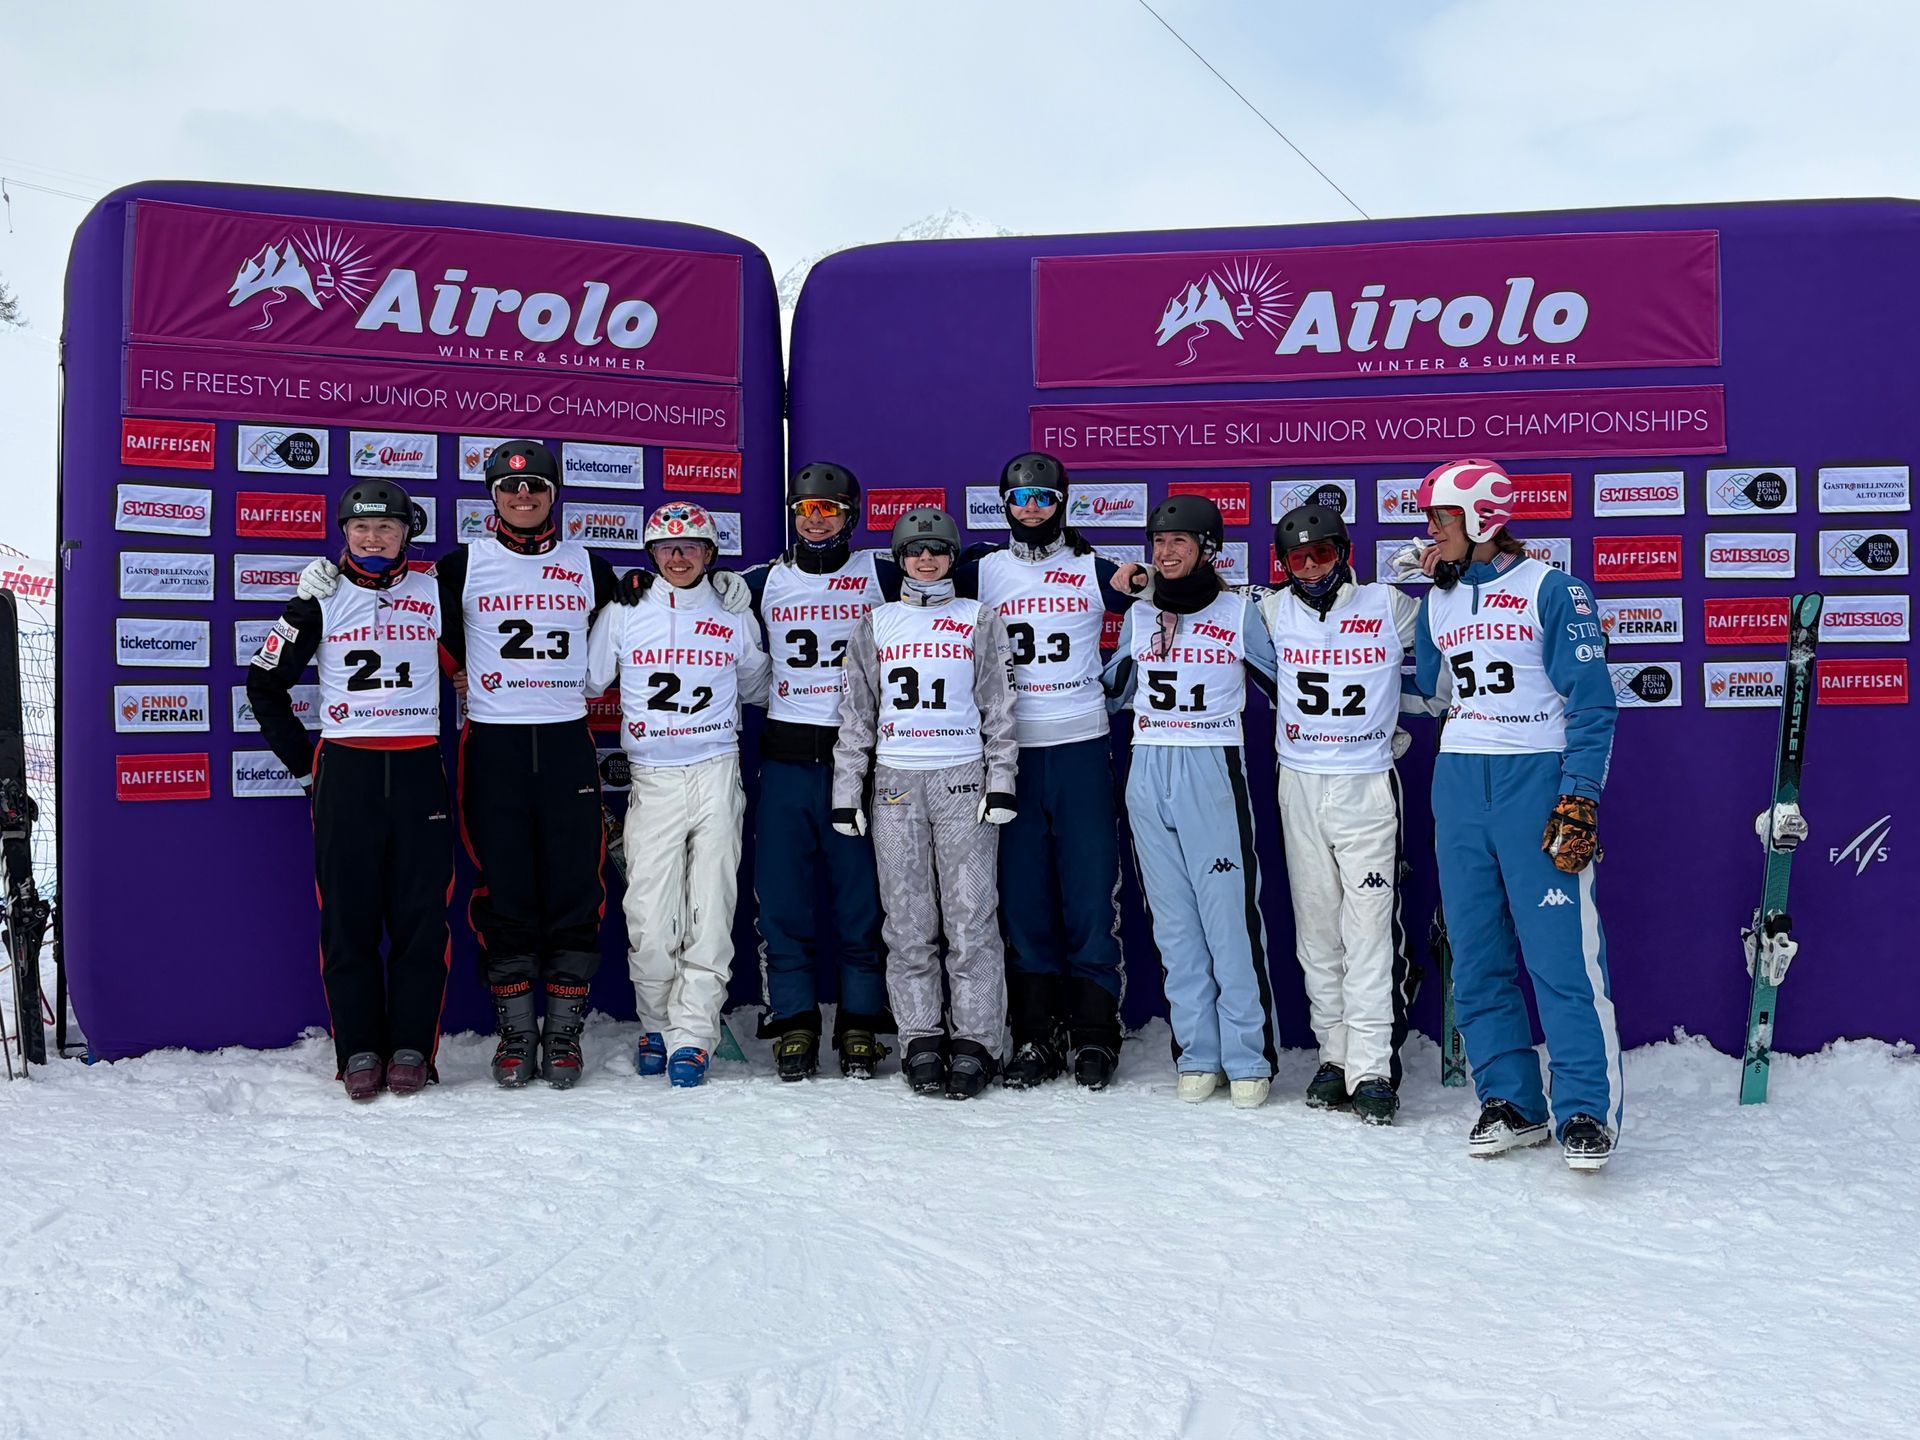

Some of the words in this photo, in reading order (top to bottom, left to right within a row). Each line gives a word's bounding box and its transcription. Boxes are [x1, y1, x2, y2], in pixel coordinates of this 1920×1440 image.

[355, 268, 658, 349] Airolo
[1275, 277, 1589, 355] Airolo
[438, 346, 524, 362] WINTER
[537, 352, 547, 363] &
[559, 353, 646, 370] SUMMER
[1357, 358, 1445, 373] WINTER
[1458, 356, 1469, 368] &
[1483, 353, 1577, 367] SUMMER
[141, 369, 174, 390] FIS
[183, 371, 311, 399] FREESTYLE
[319, 381, 352, 402] SKI
[361, 384, 448, 409] JUNIOR
[455, 390, 541, 412] WORLD
[548, 395, 726, 428] CHAMPIONSHIPS
[1045, 427, 1077, 448] FIS
[1085, 424, 1217, 447] FREESTYLE
[1225, 422, 1260, 444] SKI
[1269, 419, 1366, 443] JUNIOR
[1375, 416, 1475, 440] WORLD
[1485, 409, 1708, 437] CHAMPIONSHIPS
[126, 434, 210, 453] RAIFFEISEN
[289, 447, 313, 456] ZONA
[379, 446, 424, 465] Quinto
[566, 459, 633, 475] ticketcorner
[667, 463, 737, 479] RAIFFEISEN
[1600, 486, 1678, 502] SWISSLOS
[1756, 487, 1780, 496] ZONA
[1876, 491, 1905, 499] TICINO
[123, 500, 205, 520] SWISSLOS
[1092, 497, 1134, 515] Quinto
[240, 507, 322, 523] RAIFFEISEN
[585, 514, 626, 526] ENNIO
[584, 526, 638, 540] FERRARI
[1598, 550, 1677, 566] RAIFFEISEN
[1710, 548, 1790, 564] SWISSLOS
[1868, 548, 1892, 557] ZONA
[159, 577, 181, 585] ALTO
[182, 577, 209, 586] TICINO
[1570, 587, 1585, 596] US
[478, 594, 587, 612] RAIFFEISEN
[772, 604, 872, 622] RAIFFEISEN
[1618, 608, 1662, 620] ENNIO
[1708, 614, 1788, 628] RAIFFEISEN
[1823, 611, 1903, 627] SWISSLOS
[1618, 620, 1677, 633] FERRARI
[120, 635, 197, 651] ticketcorner
[498, 619, 570, 660] 2.3
[1006, 622, 1070, 665] 3.3
[1438, 623, 1534, 652] RAIFFEISEN
[785, 628, 848, 668] 3.2
[632, 648, 735, 667] RAIFFEISEN
[1283, 647, 1387, 666] RAIFFEISEN
[344, 649, 413, 692] 2.1
[1450, 650, 1515, 699] 5.3
[1728, 672, 1773, 684] ENNIO
[507, 677, 585, 689] welovesnow.ch
[887, 666, 947, 710] 3.1
[1642, 680, 1666, 689] ZONA
[1821, 674, 1903, 689] RAIFFEISEN
[647, 671, 713, 715] 2.2
[1147, 670, 1208, 712] 5.1
[1296, 671, 1366, 717] 5.2
[1728, 683, 1783, 698] FERRAR
[141, 695, 188, 708] ENNIO
[141, 709, 203, 721] FERRARI
[650, 718, 734, 738] welovesnow.ch
[1152, 717, 1236, 730] welovesnow.ch
[897, 726, 976, 738] welovesnow.ch
[1302, 729, 1387, 743] welovesnow.ch
[121, 769, 205, 785] RAIFFEISEN
